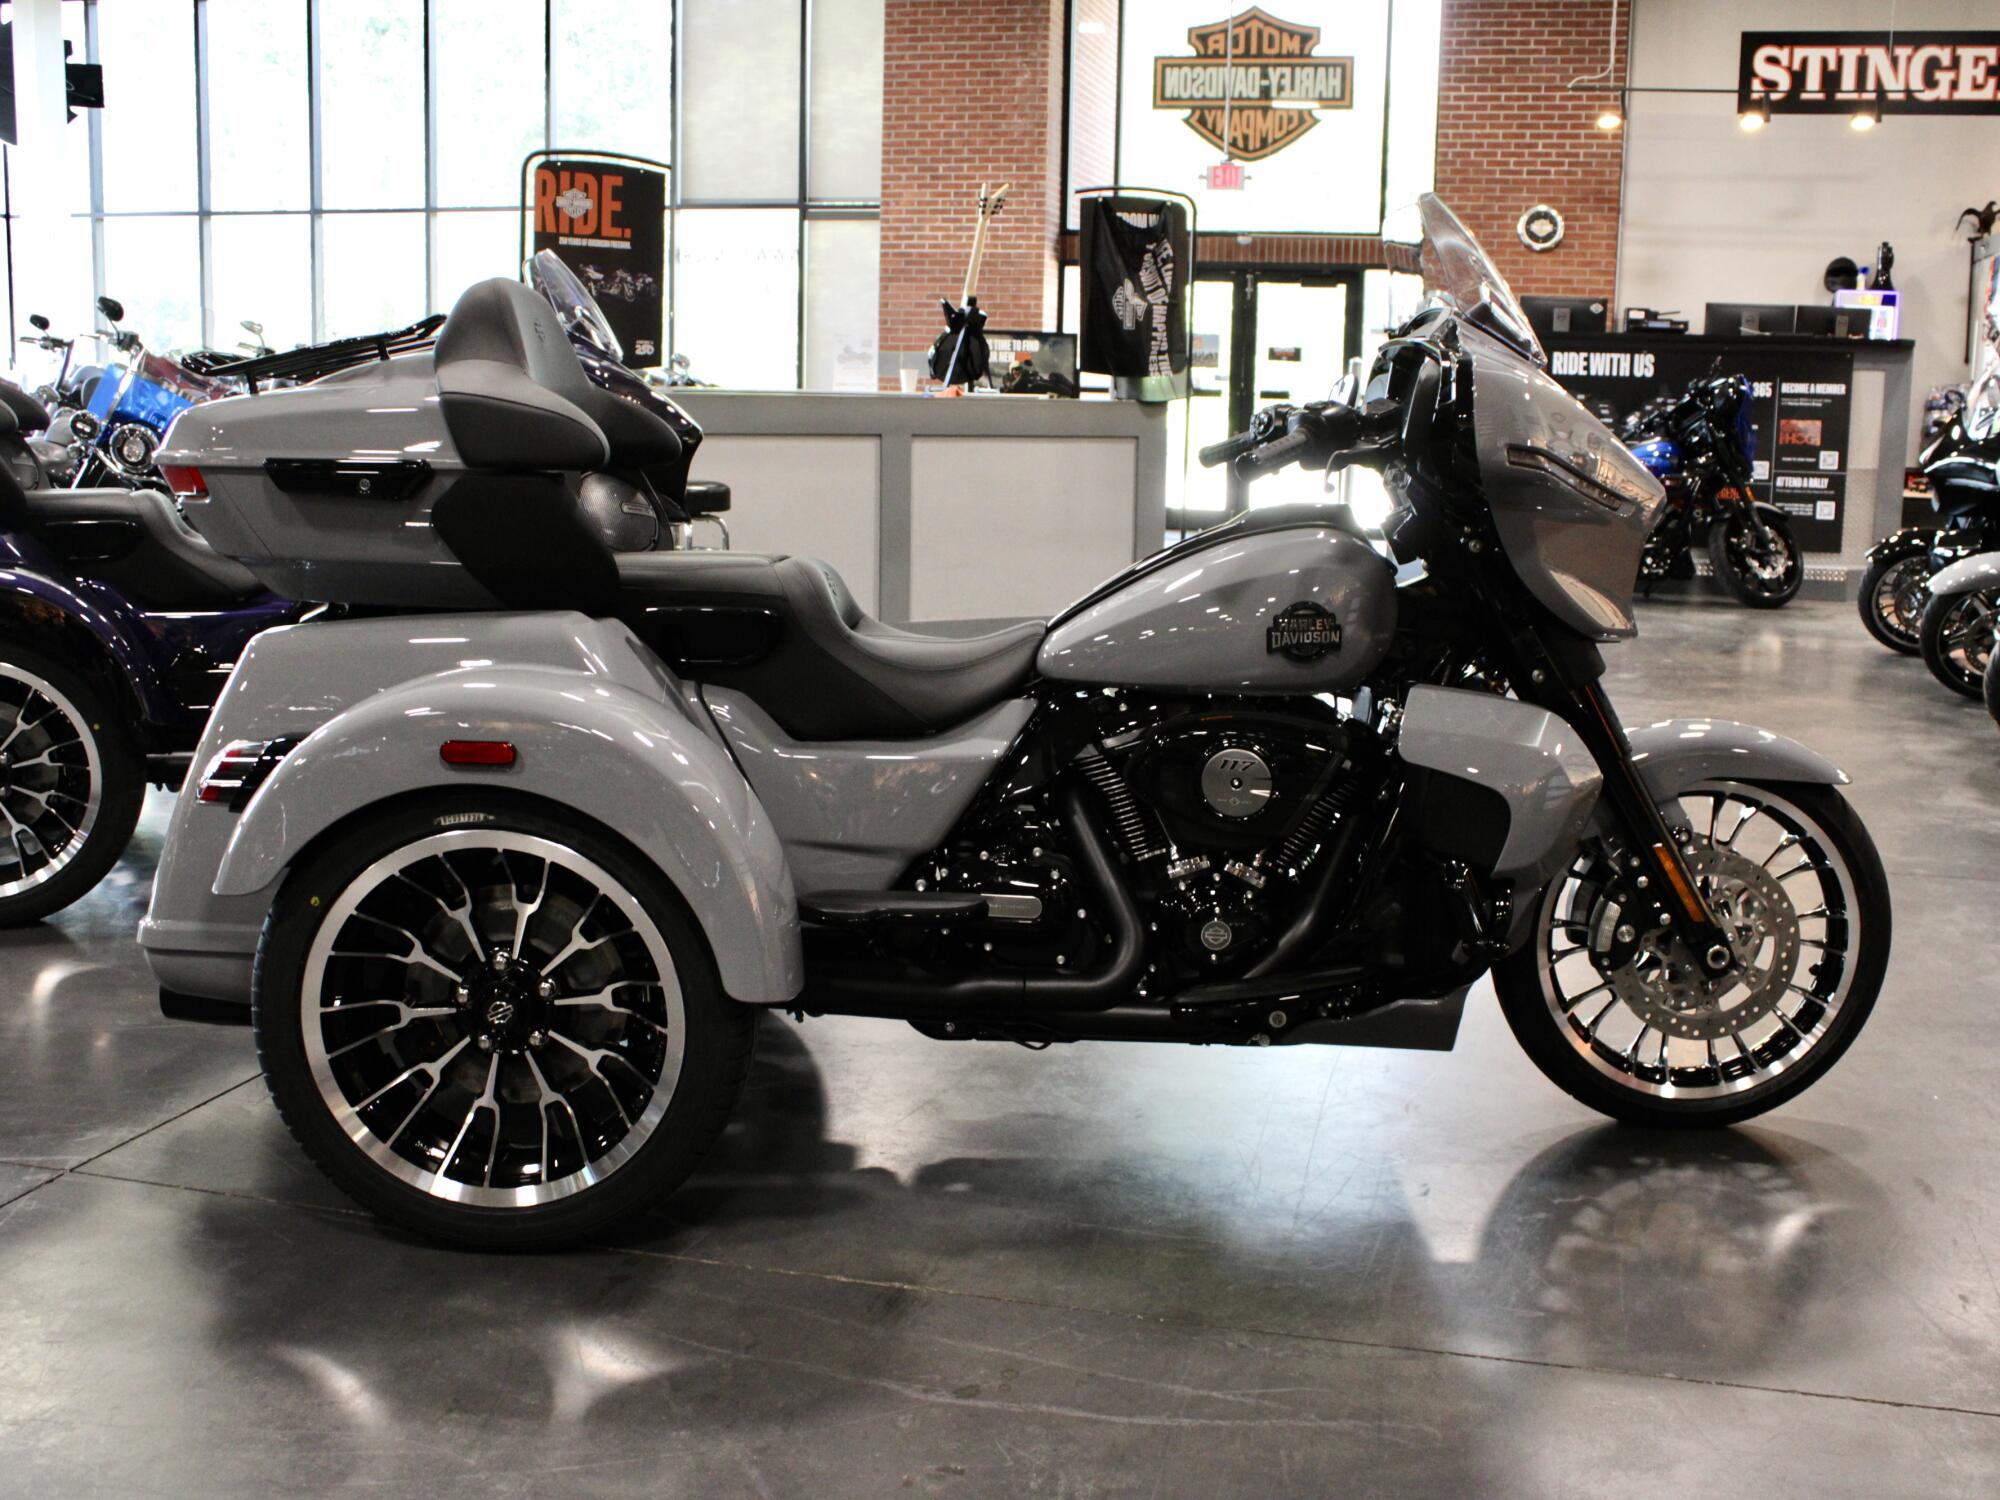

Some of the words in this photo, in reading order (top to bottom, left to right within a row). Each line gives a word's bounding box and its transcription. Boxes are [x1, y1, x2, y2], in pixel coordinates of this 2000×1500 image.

[1750, 44, 2000, 101] STINGE
[1213, 167, 1241, 188] EXIT
[1147, 287, 1170, 305] OF
[1552, 351, 1588, 376] RIDE
[1589, 352, 1631, 377] WITH
[1633, 353, 1655, 378] US
[1781, 382, 1810, 395] BECOME
[1815, 383, 1847, 396] MEMBER
[1776, 476, 1803, 489] ATTEND
[1808, 477, 1830, 490] RALLY
[1272, 631, 1340, 649] DAVIDSON
[1219, 759, 1257, 771] 117
